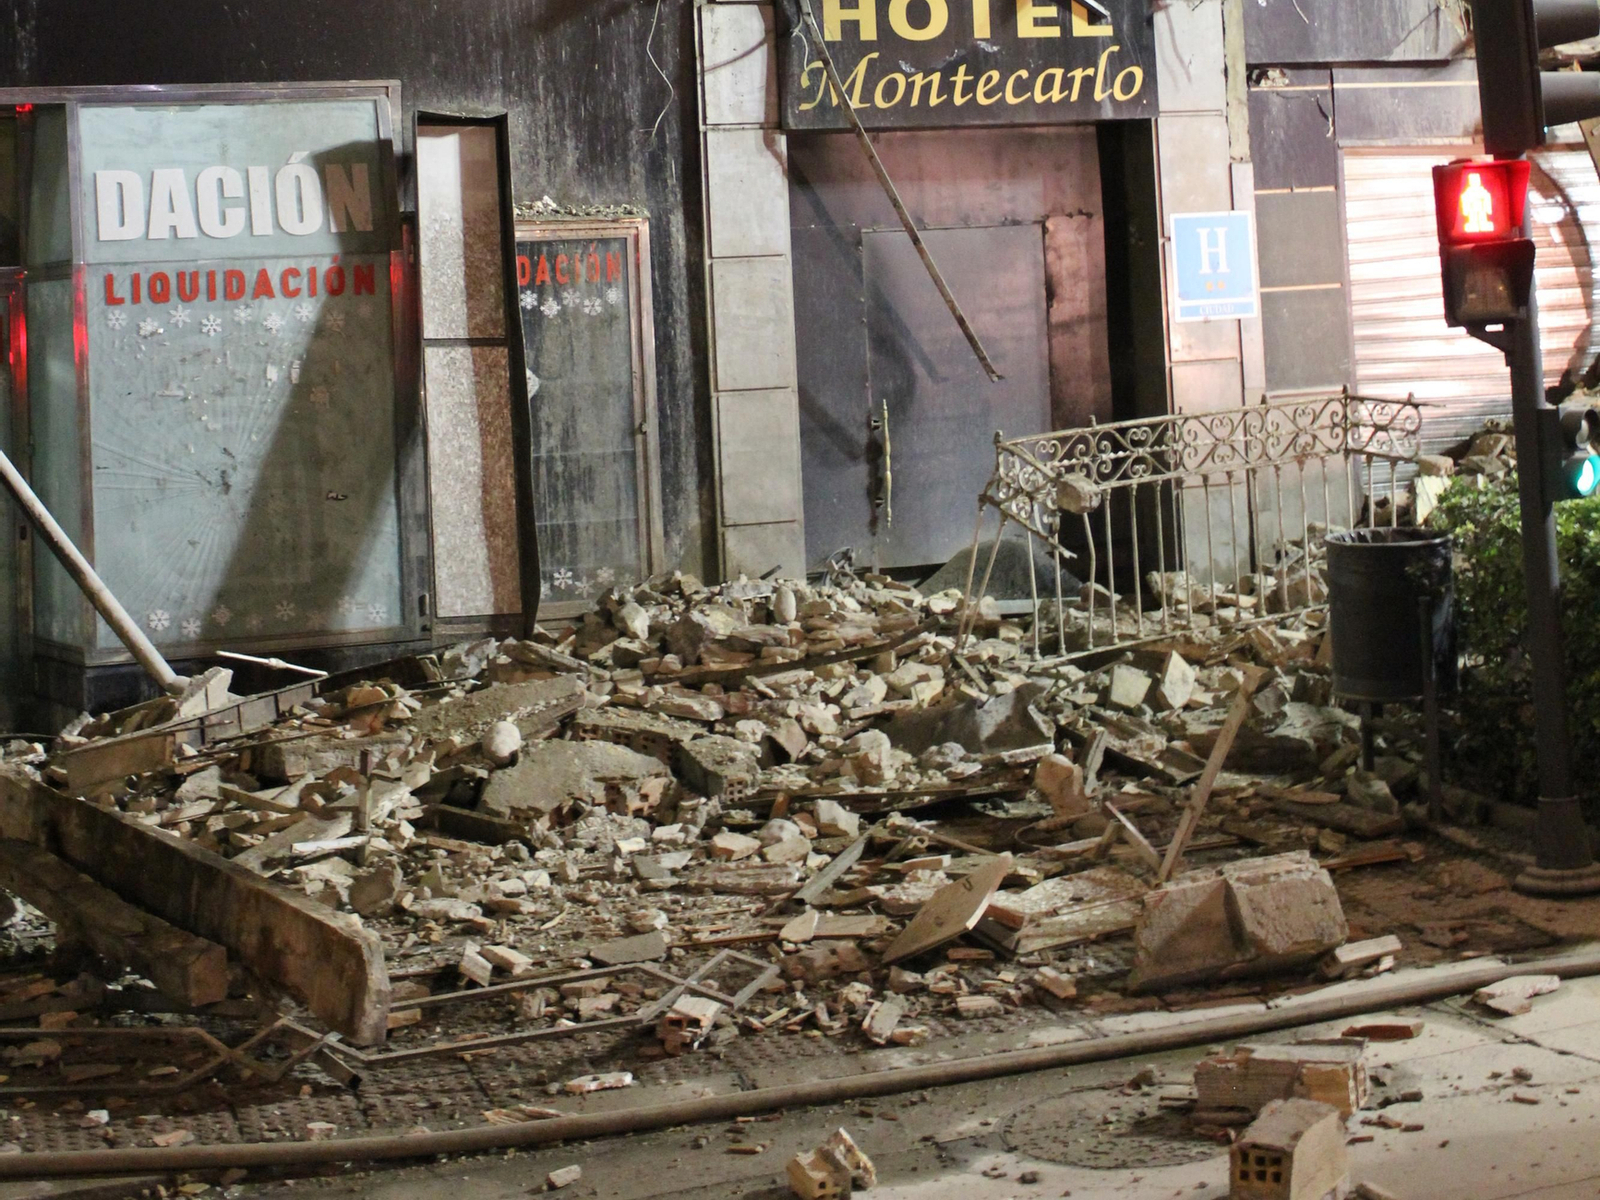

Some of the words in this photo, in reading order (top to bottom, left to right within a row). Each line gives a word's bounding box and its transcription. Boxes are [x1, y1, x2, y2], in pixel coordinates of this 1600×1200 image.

[797, 45, 1144, 110] Montecarlo
[95, 151, 375, 241] DACIÓN
[105, 255, 376, 304] LIQUIDACIÓN
[1196, 227, 1231, 275] H
